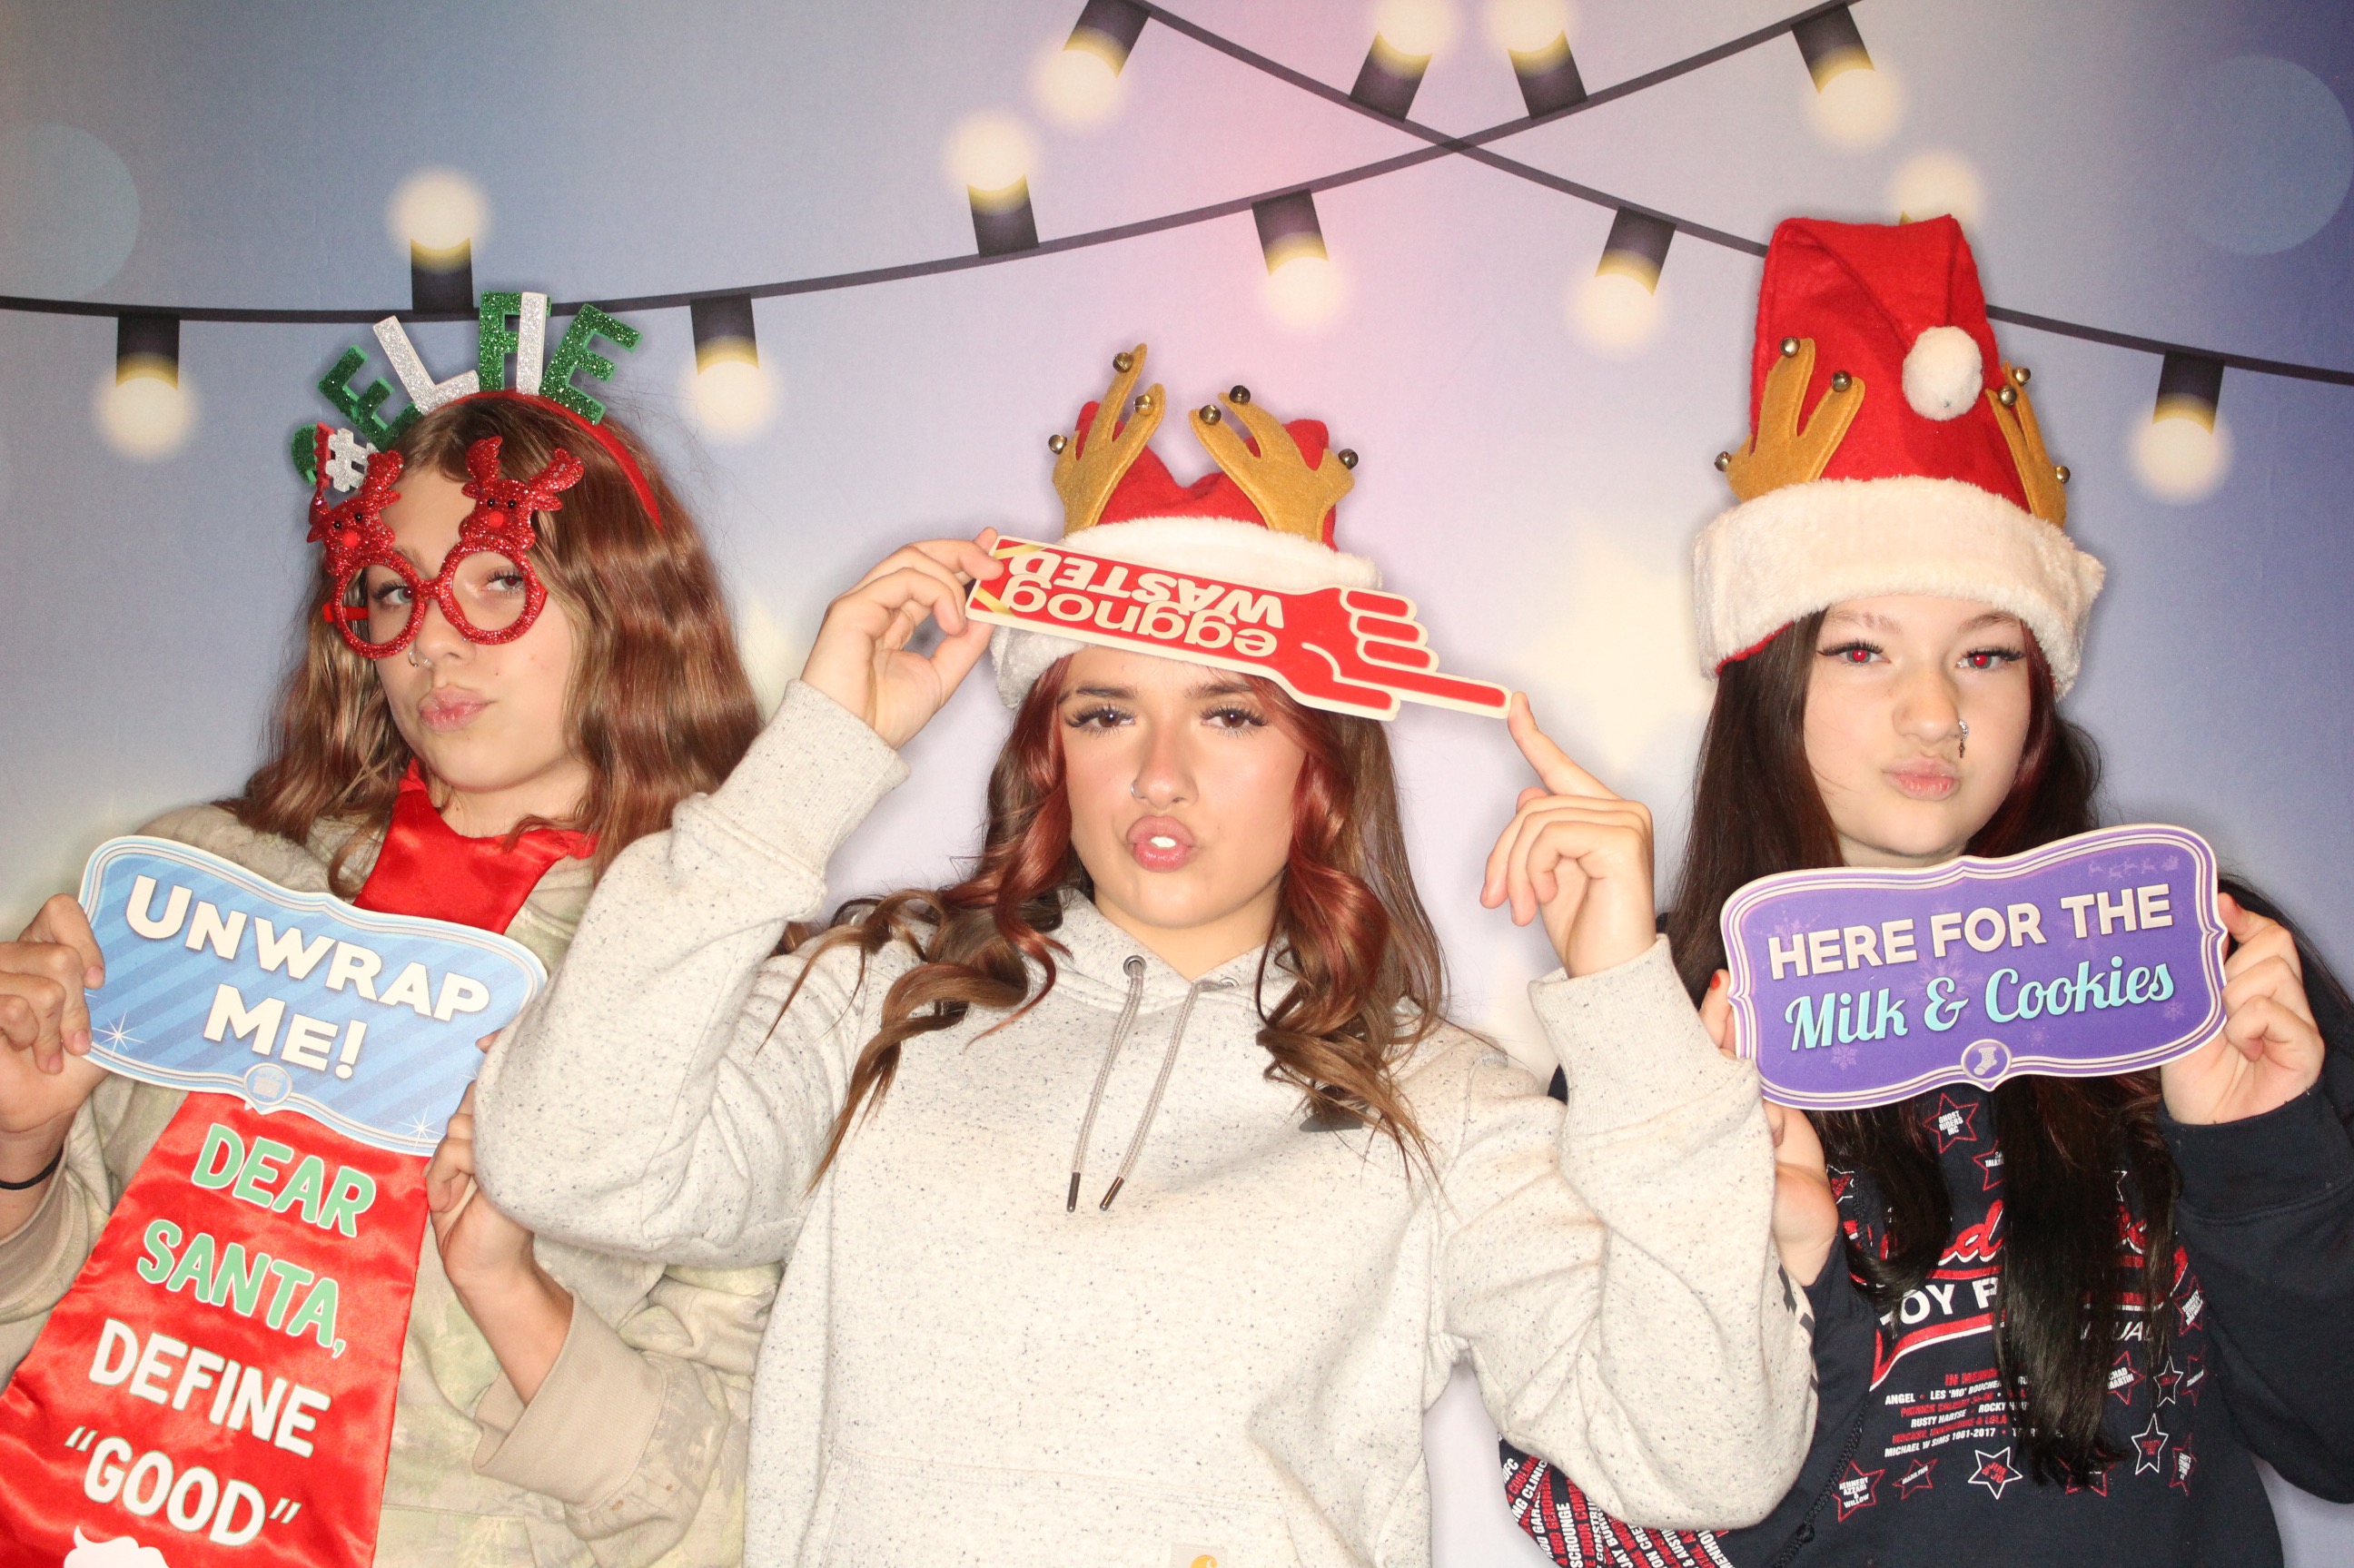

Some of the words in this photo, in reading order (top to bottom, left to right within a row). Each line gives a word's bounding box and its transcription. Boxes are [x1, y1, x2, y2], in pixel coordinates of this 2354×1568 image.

[1008, 544, 1284, 628] WASTED
[1003, 573, 1278, 657] eggnog
[124, 874, 491, 1023] UNWRAP
[1768, 918, 1918, 981] HERE
[1930, 902, 2047, 958] FOR
[2060, 883, 2174, 940] THE
[1784, 987, 1908, 1052] Milk
[1924, 976, 1969, 1032] &
[1984, 955, 2175, 1023] Cookies
[203, 983, 368, 1080] ME!
[1938, 1110, 1960, 1123] GHOST
[1939, 1117, 1963, 1131] RIDERS
[1947, 1126, 1959, 1136] MC
[190, 1122, 377, 1238] DEAR
[136, 1218, 348, 1359] SANTA,
[87, 1317, 332, 1456] DEFINE
[1885, 1393, 1915, 1405] ANGEL
[1930, 1390, 1946, 1401] LES
[1945, 1374, 1959, 1386] IN
[1911, 1416, 1937, 1428] RUSTY
[1978, 1402, 2006, 1413] ROCKY
[1884, 1443, 1920, 1457] MICHAEL
[1931, 1434, 1950, 1447] SIMS
[1522, 1460, 1548, 1499] CLINIC
[1839, 1476, 1868, 1491] KENNEDY
[1844, 1493, 1869, 1508] WILLOW
[1556, 1503, 1584, 1568] SCROUNGE
[1611, 1549, 1634, 1568] JAY
